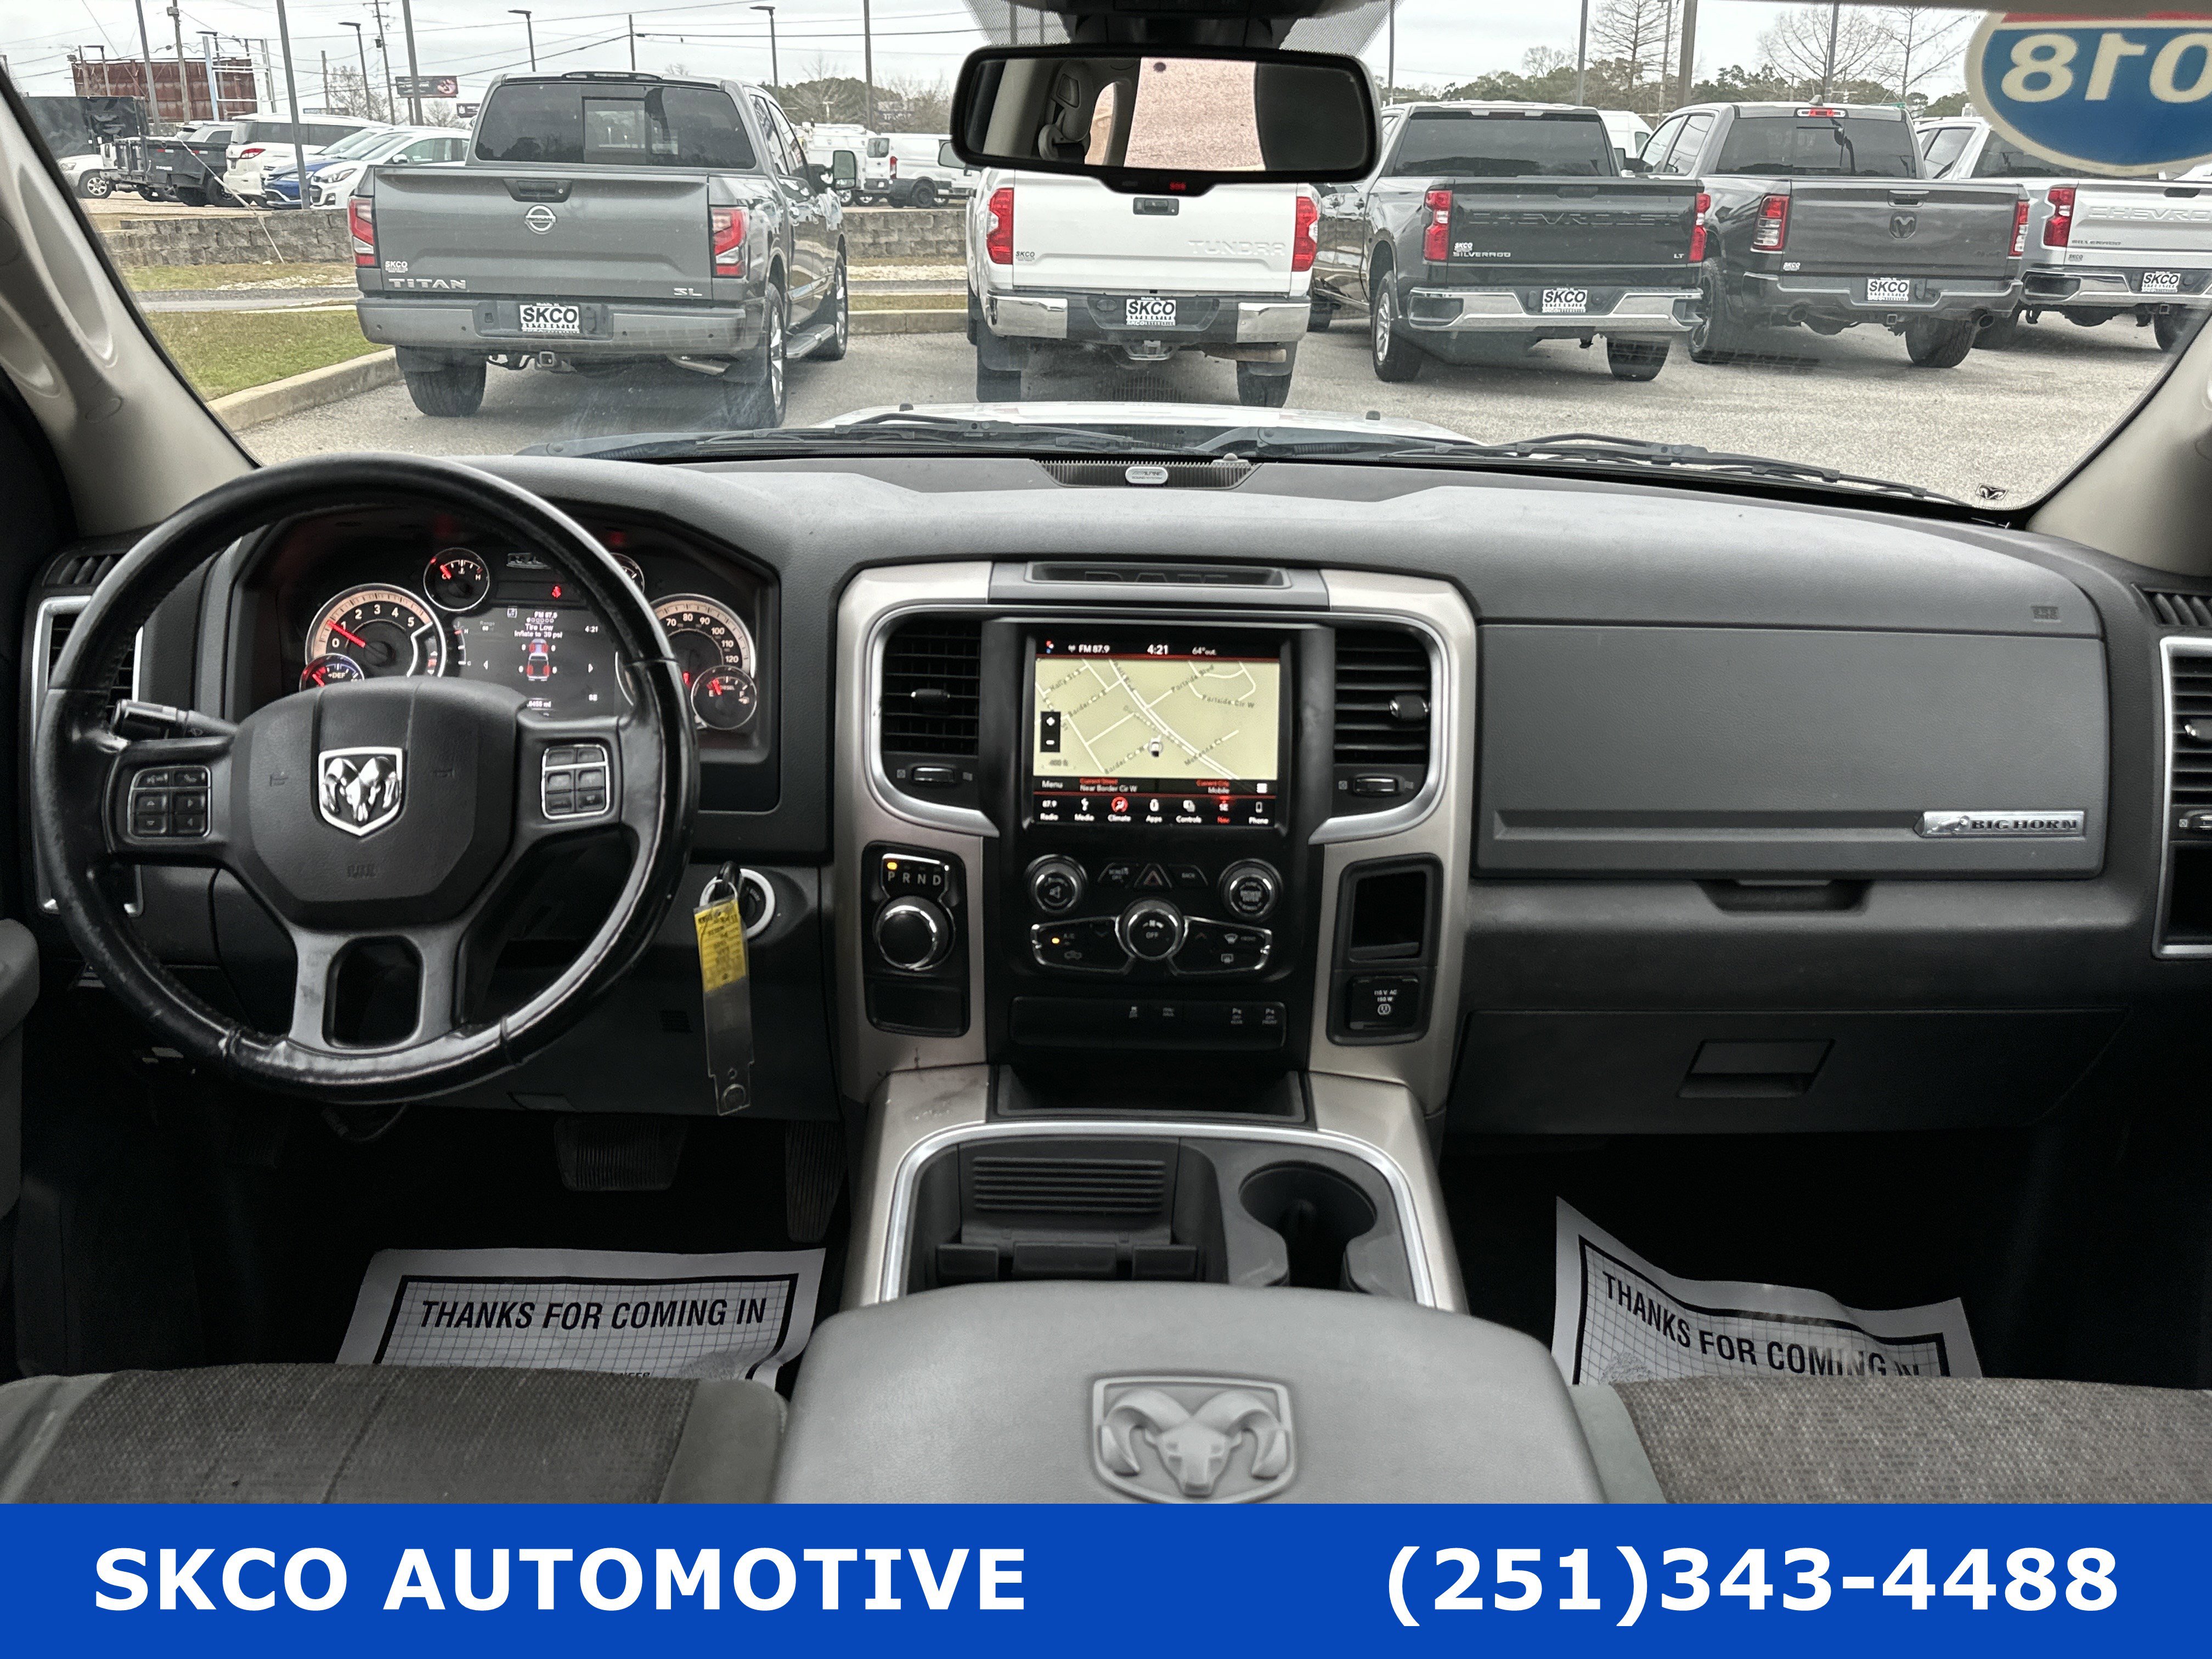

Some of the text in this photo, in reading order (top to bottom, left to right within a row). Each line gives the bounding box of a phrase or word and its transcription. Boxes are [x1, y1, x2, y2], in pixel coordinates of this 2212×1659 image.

[1188, 240, 1285, 256] TUNDRA
[388, 278, 466, 290] TITAN
[2144, 274, 2179, 284] SKCO
[1869, 281, 1908, 292] SKCO
[673, 288, 703, 297] SL
[1544, 291, 1586, 303] SKCO
[1128, 301, 1175, 315] SKCO
[523, 307, 578, 323] SKCO
[354, 609, 362, 619] 2
[374, 604, 381, 614] 3
[392, 607, 399, 618] 4
[408, 617, 414, 627] 5
[665, 618, 676, 627] 70
[682, 613, 693, 622] 80
[699, 617, 710, 625] 90
[341, 621, 346, 630] 1
[712, 627, 725, 635] 100
[331, 638, 340, 648] 0
[721, 640, 734, 648] 110
[1079, 644, 1110, 653] FM 87.9
[1147, 644, 1169, 655] 4:21
[725, 655, 739, 663] 120
[1042, 780, 1063, 789] Menu
[1040, 812, 1059, 821] Radio
[1074, 813, 1094, 821] Media
[1108, 814, 1132, 822] Climate
[1248, 816, 1269, 825] Phone
[1971, 820, 2077, 830] BIG HORN
[888, 871, 941, 886] P R N D
[421, 1297, 767, 1330] THANKS FOR COMING IN
[1602, 1271, 1692, 1349] THANKS
[1700, 1329, 1757, 1366] FOR
[1767, 1340, 1887, 1376] COMING
